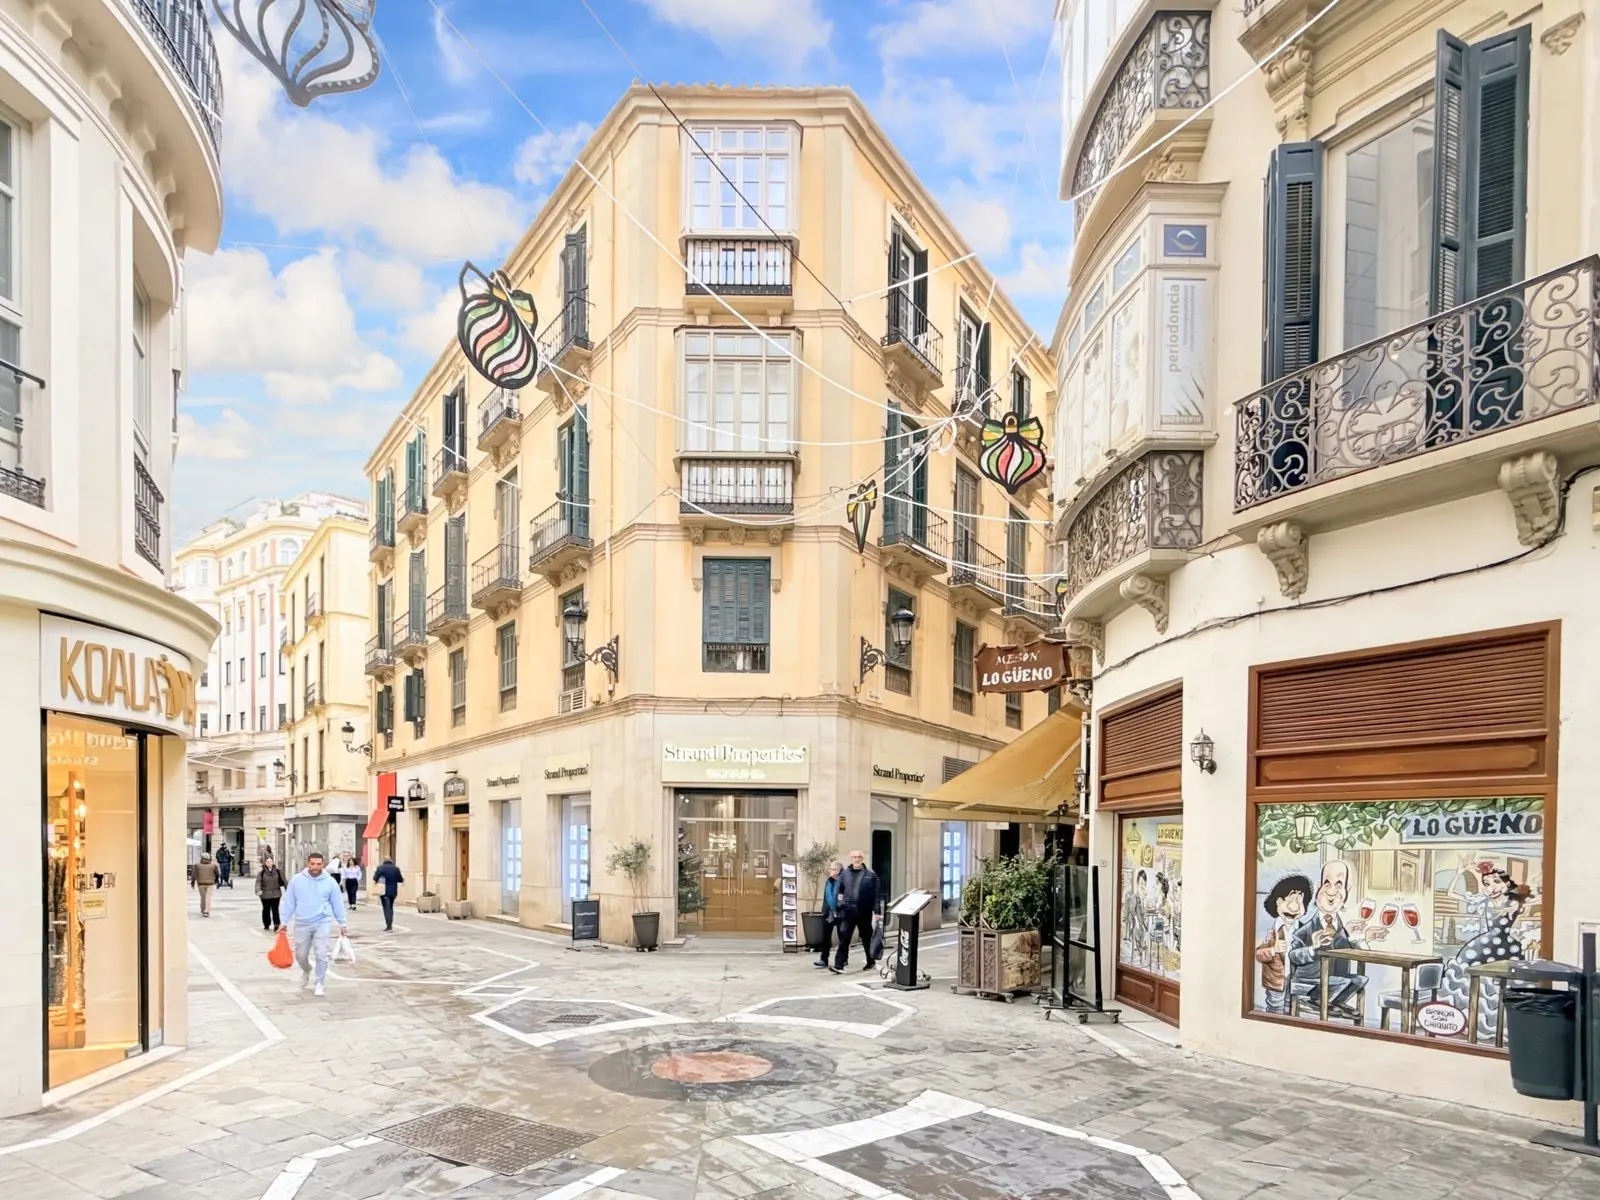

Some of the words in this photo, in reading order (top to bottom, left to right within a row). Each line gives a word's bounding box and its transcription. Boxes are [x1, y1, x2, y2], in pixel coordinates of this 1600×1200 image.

[1166, 284, 1181, 373] periodoncia
[59, 636, 162, 717] KOALA
[982, 672, 1000, 686] LO
[1002, 666, 1053, 684] GÜENO
[664, 744, 717, 761] Strand
[722, 744, 803, 766] Properties
[544, 768, 561, 780] Strand
[561, 766, 588, 780] Properties
[873, 764, 894, 779] Strand
[895, 768, 924, 784] Properties
[1413, 818, 1440, 836] LO
[1445, 811, 1543, 835] GÜENO
